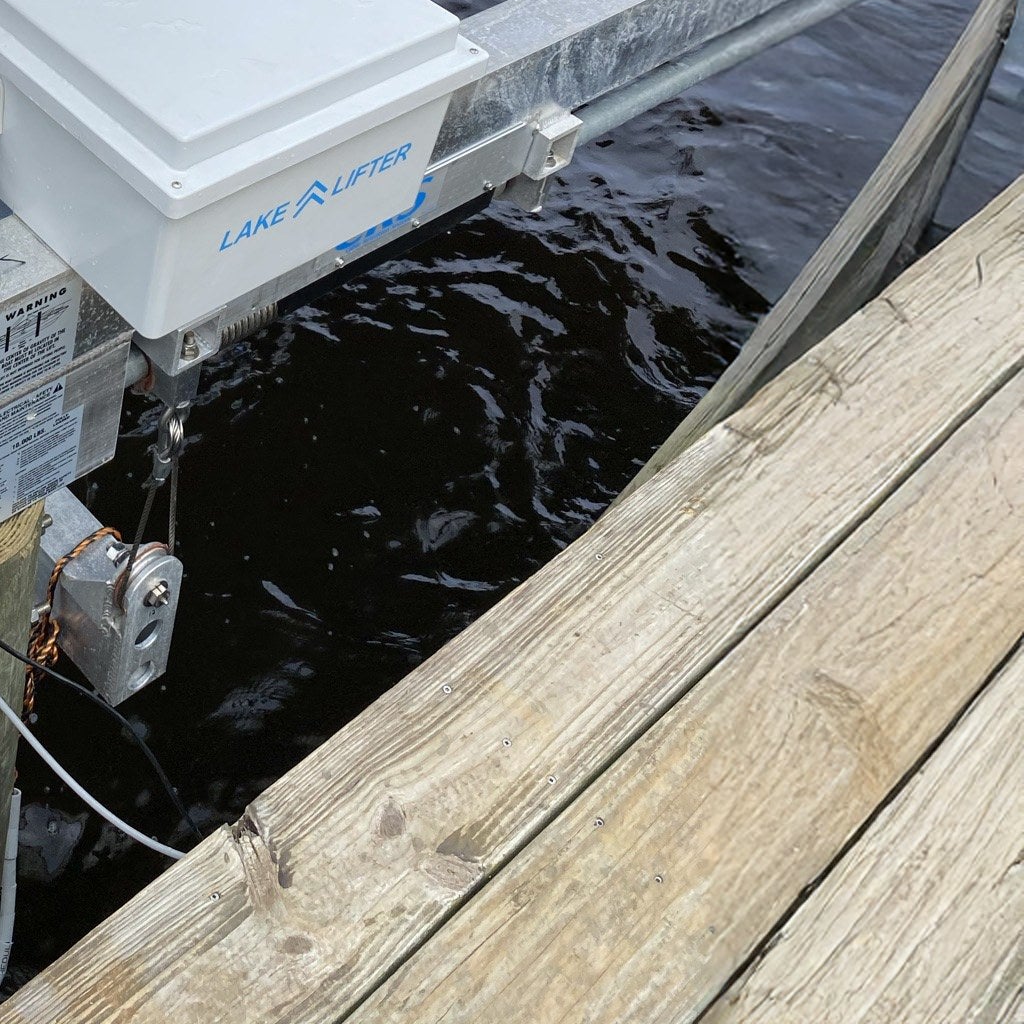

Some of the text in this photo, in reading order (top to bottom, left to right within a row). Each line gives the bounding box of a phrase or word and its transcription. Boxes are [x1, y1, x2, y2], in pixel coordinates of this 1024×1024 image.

[219, 201, 291, 252] LAKE
[331, 142, 412, 197] LIFTER
[6, 288, 66, 322] WARNING
[5, 350, 23, 362] CENTER
[30, 335, 49, 349] GRAVITY
[57, 328, 65, 336] THE
[14, 352, 26, 362] MUST
[34, 339, 52, 352] LOCATED
[13, 356, 28, 368] CENTER
[11, 392, 50, 416] MAINTENANCE
